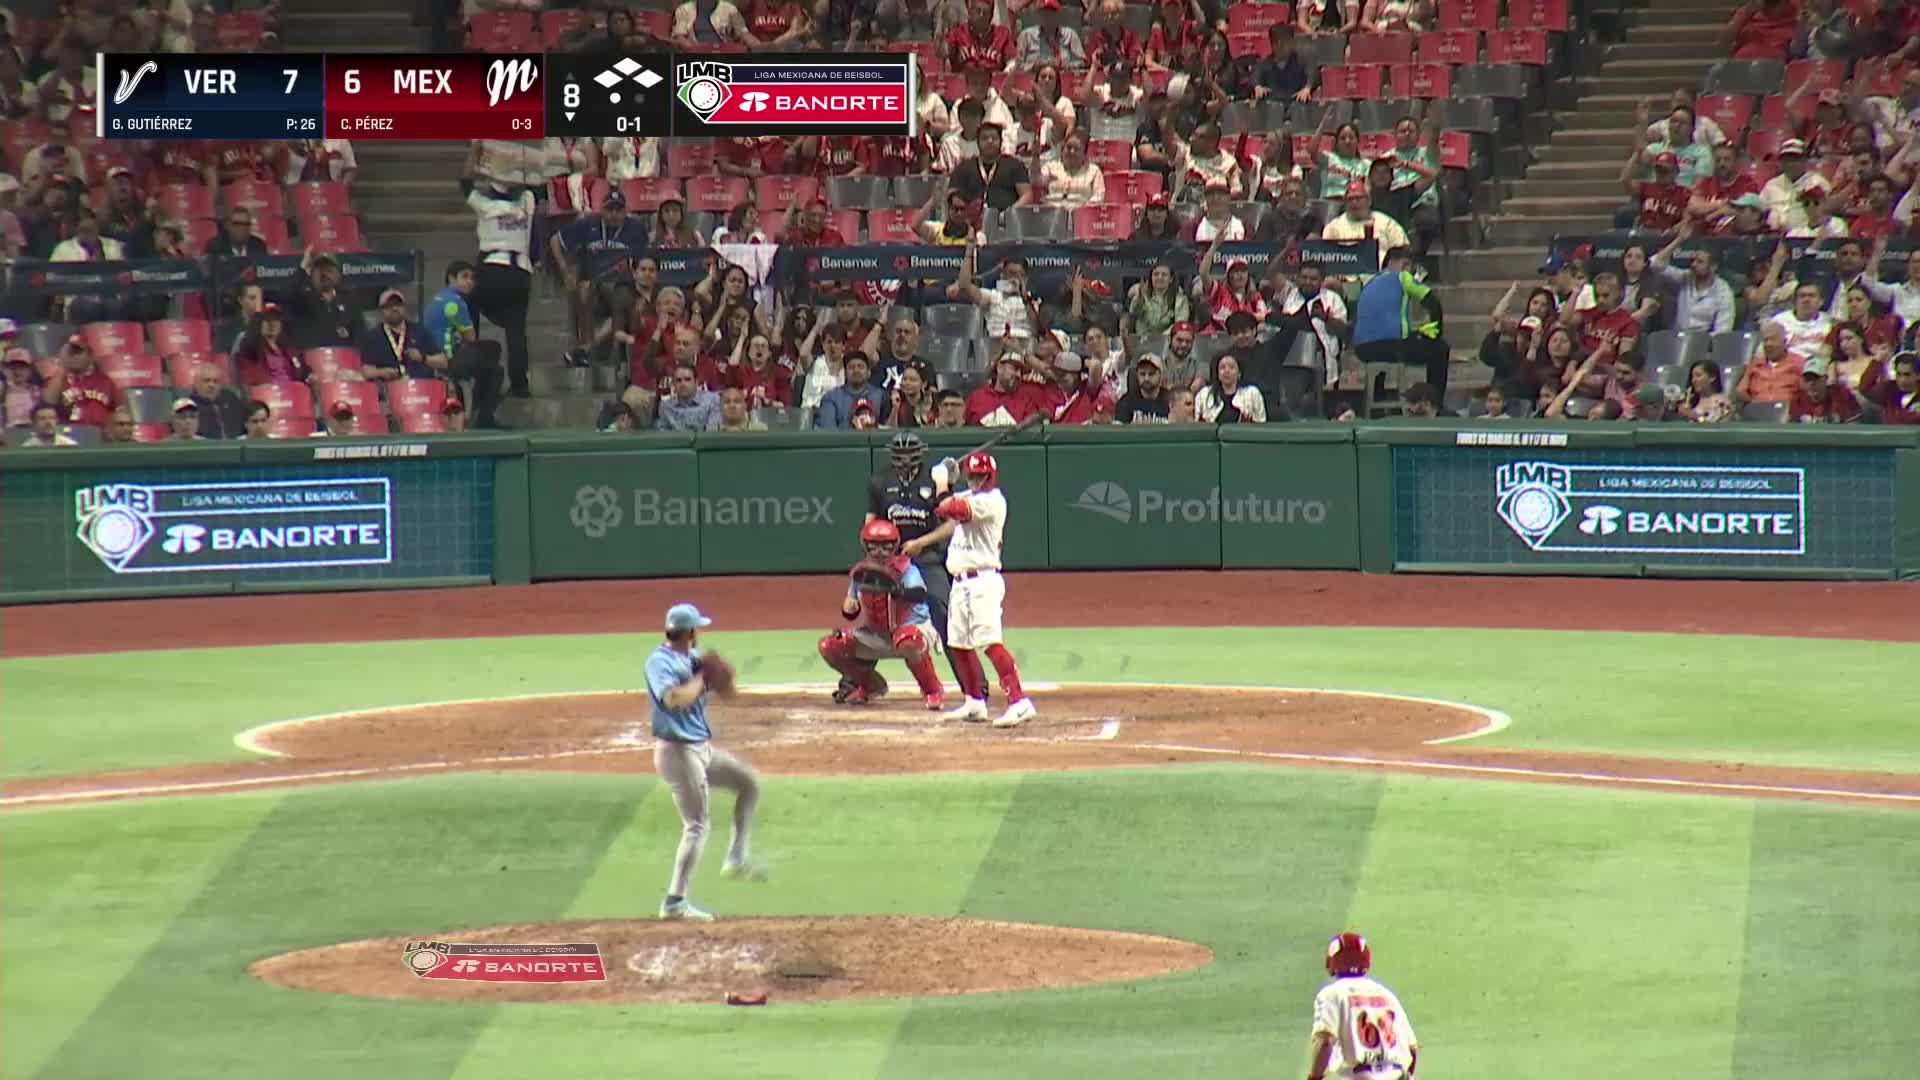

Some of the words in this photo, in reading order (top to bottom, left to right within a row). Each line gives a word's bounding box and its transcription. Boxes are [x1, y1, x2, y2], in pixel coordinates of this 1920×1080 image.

[821, 256, 879, 269] Banamex
[1301, 250, 1358, 262] Banamex
[256, 265, 296, 278] Banam
[342, 263, 397, 275] Banamex
[634, 488, 833, 527] Banamex
[1138, 487, 1327, 523] Profuturo
[1628, 511, 1793, 534] BANORTE
[212, 523, 381, 550] BANORTE
